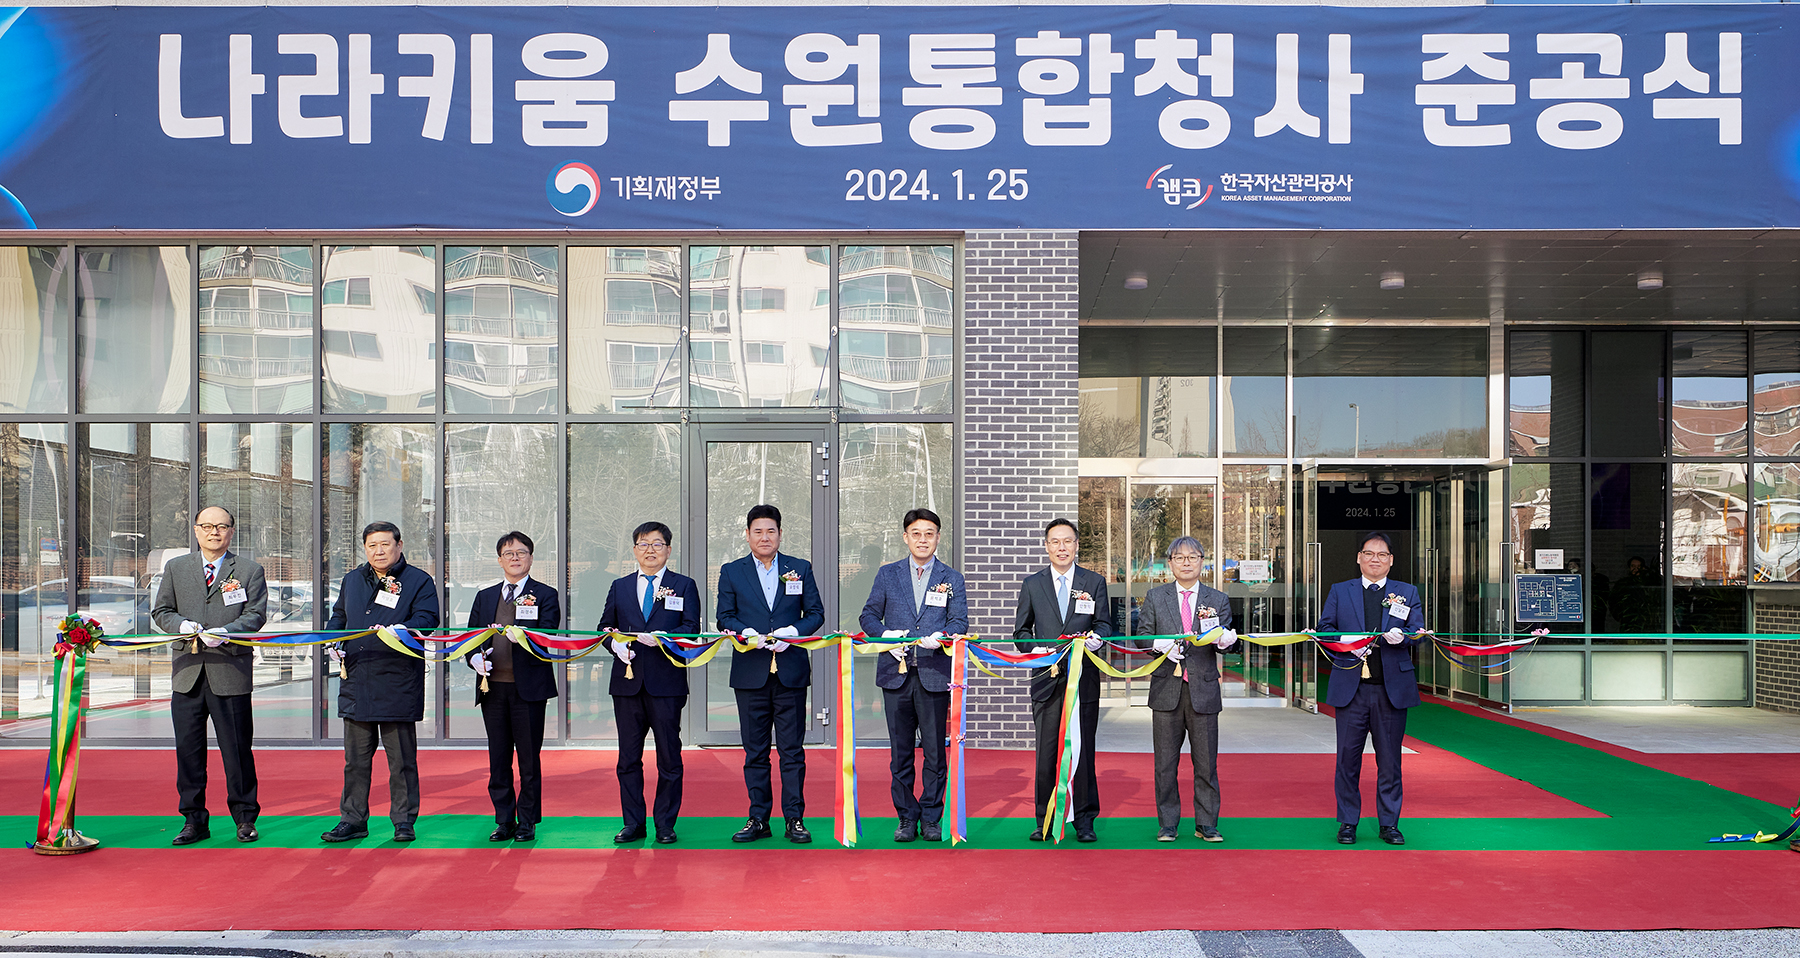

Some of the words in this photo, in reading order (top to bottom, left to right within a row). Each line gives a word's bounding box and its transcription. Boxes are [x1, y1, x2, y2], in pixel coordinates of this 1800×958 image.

[158, 33, 616, 147] 나라키움
[668, 30, 1364, 150] 수원통합청사
[1415, 32, 1742, 150] 준공식
[611, 176, 722, 200] 기획재정부
[846, 169, 939, 201] 2024.
[952, 169, 975, 201] 1.
[987, 169, 1029, 201] 25
[1157, 178, 1201, 205] 캠코
[1220, 173, 1353, 193] 한국자산관리공사
[1345, 508, 1371, 518] 2024.
[1384, 508, 1396, 518] 25
